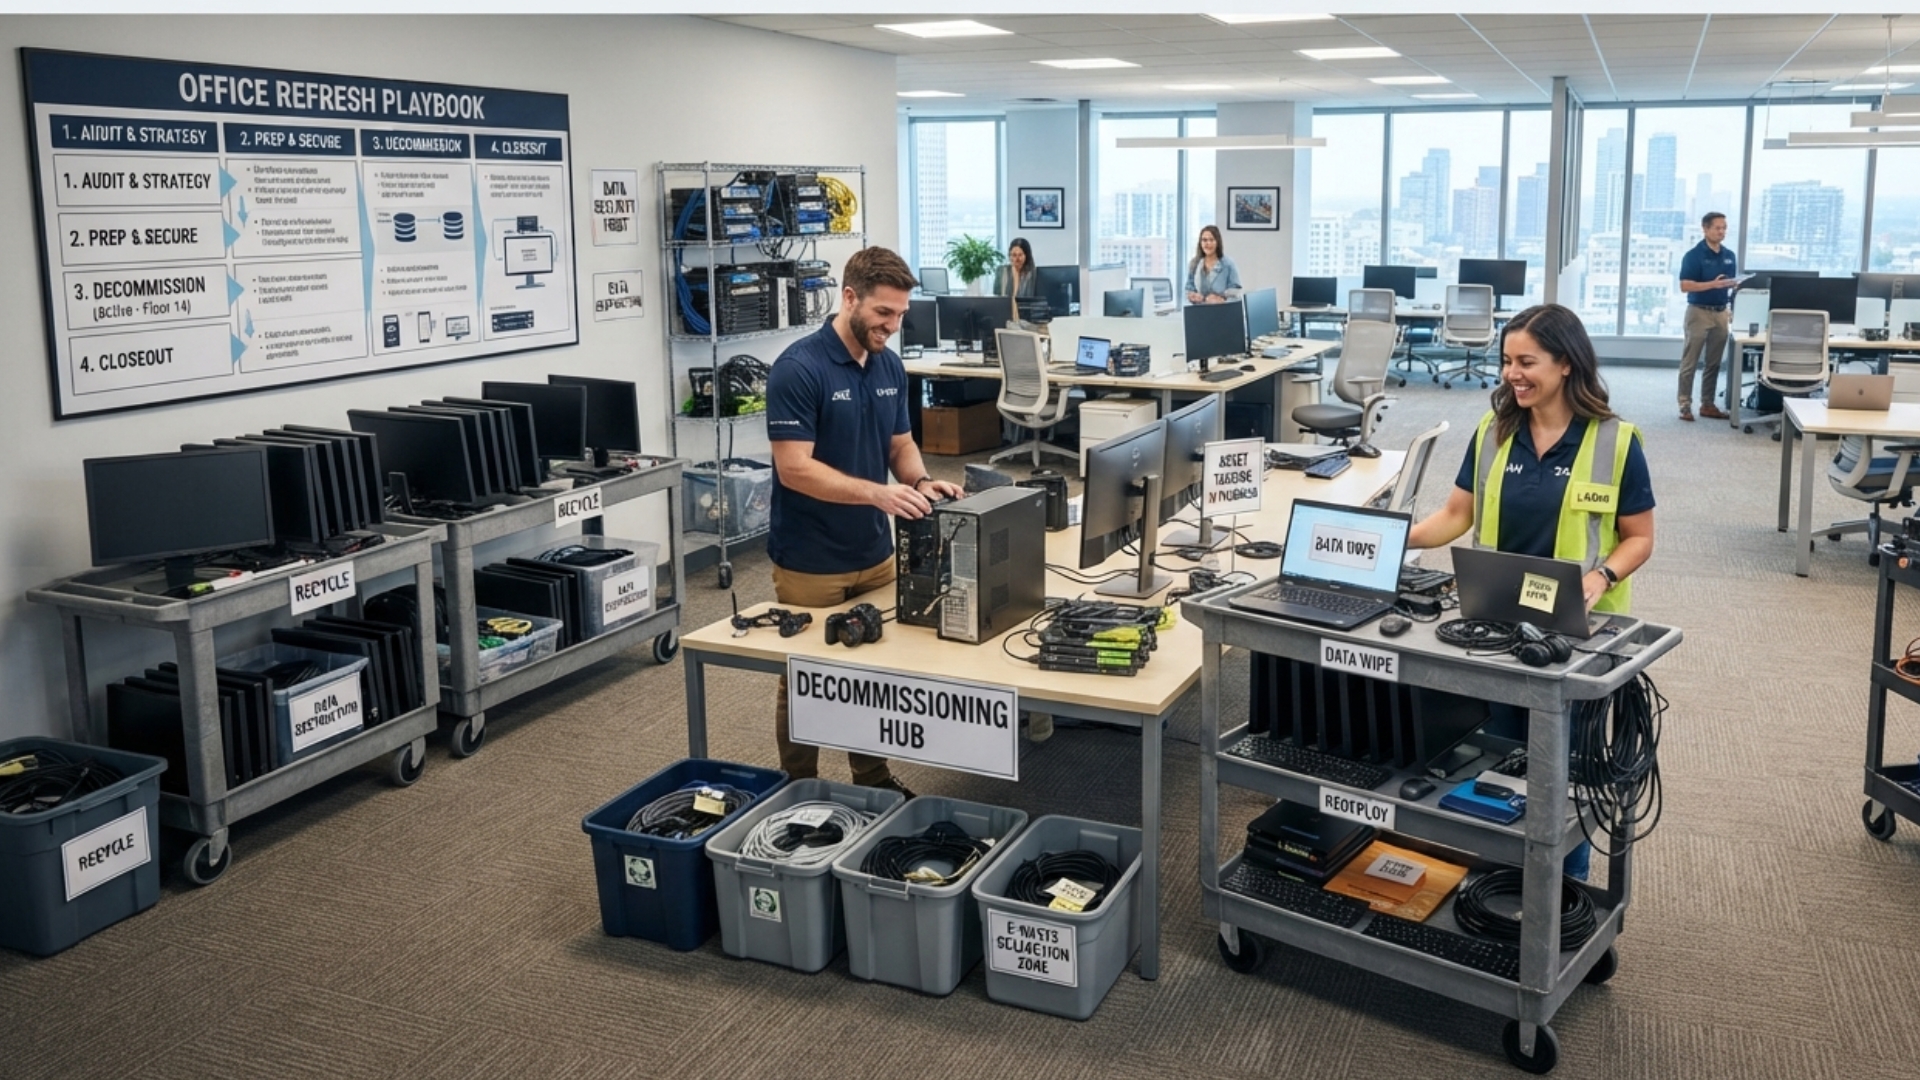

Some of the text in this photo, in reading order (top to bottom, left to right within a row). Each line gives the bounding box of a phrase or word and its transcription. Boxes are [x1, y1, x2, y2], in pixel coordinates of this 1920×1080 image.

[178, 72, 486, 120] OFFICE REFRESH PLAYBOOK
[63, 171, 212, 190] 1. AUDIT & STRATEGY
[69, 229, 85, 248] 2.
[88, 228, 127, 247] PREP
[144, 227, 199, 246] SECURE
[73, 275, 206, 301] 3. DECOMMISSION
[79, 347, 174, 373] 4. CLOSEOUT
[1325, 645, 1394, 674] DATA WIPE
[796, 669, 1009, 730] DECOMMISSIONING
[879, 717, 925, 749] HUB
